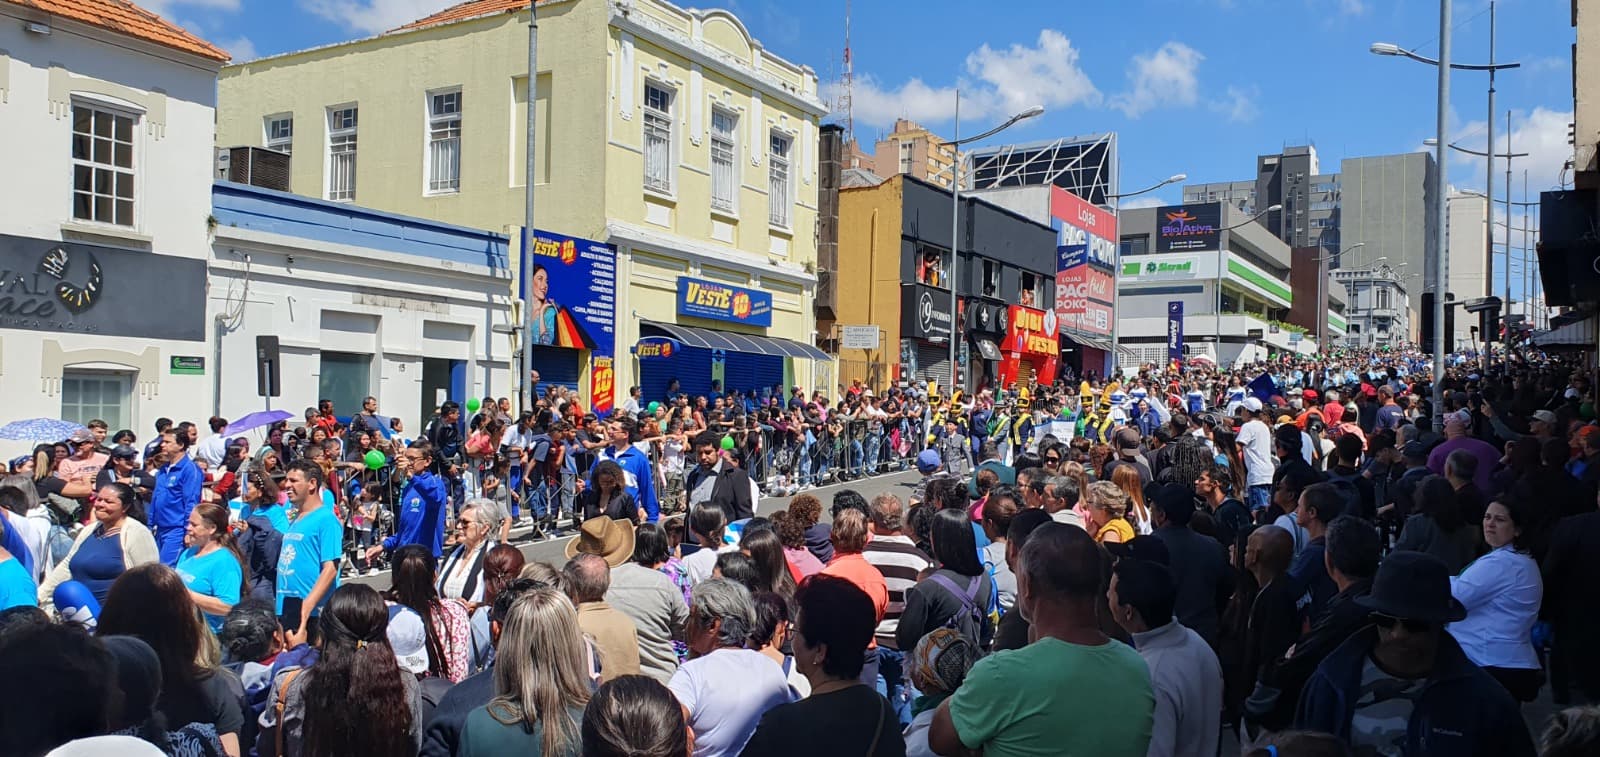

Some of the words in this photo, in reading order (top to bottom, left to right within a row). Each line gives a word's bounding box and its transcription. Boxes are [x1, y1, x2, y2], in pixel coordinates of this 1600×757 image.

[1078, 203, 1096, 227] Lojas
[686, 282, 733, 309] VESTE
[732, 294, 750, 316] 10
[1056, 282, 1088, 298] PAG
[1056, 299, 1088, 309] POKO
[593, 368, 613, 396] 10
